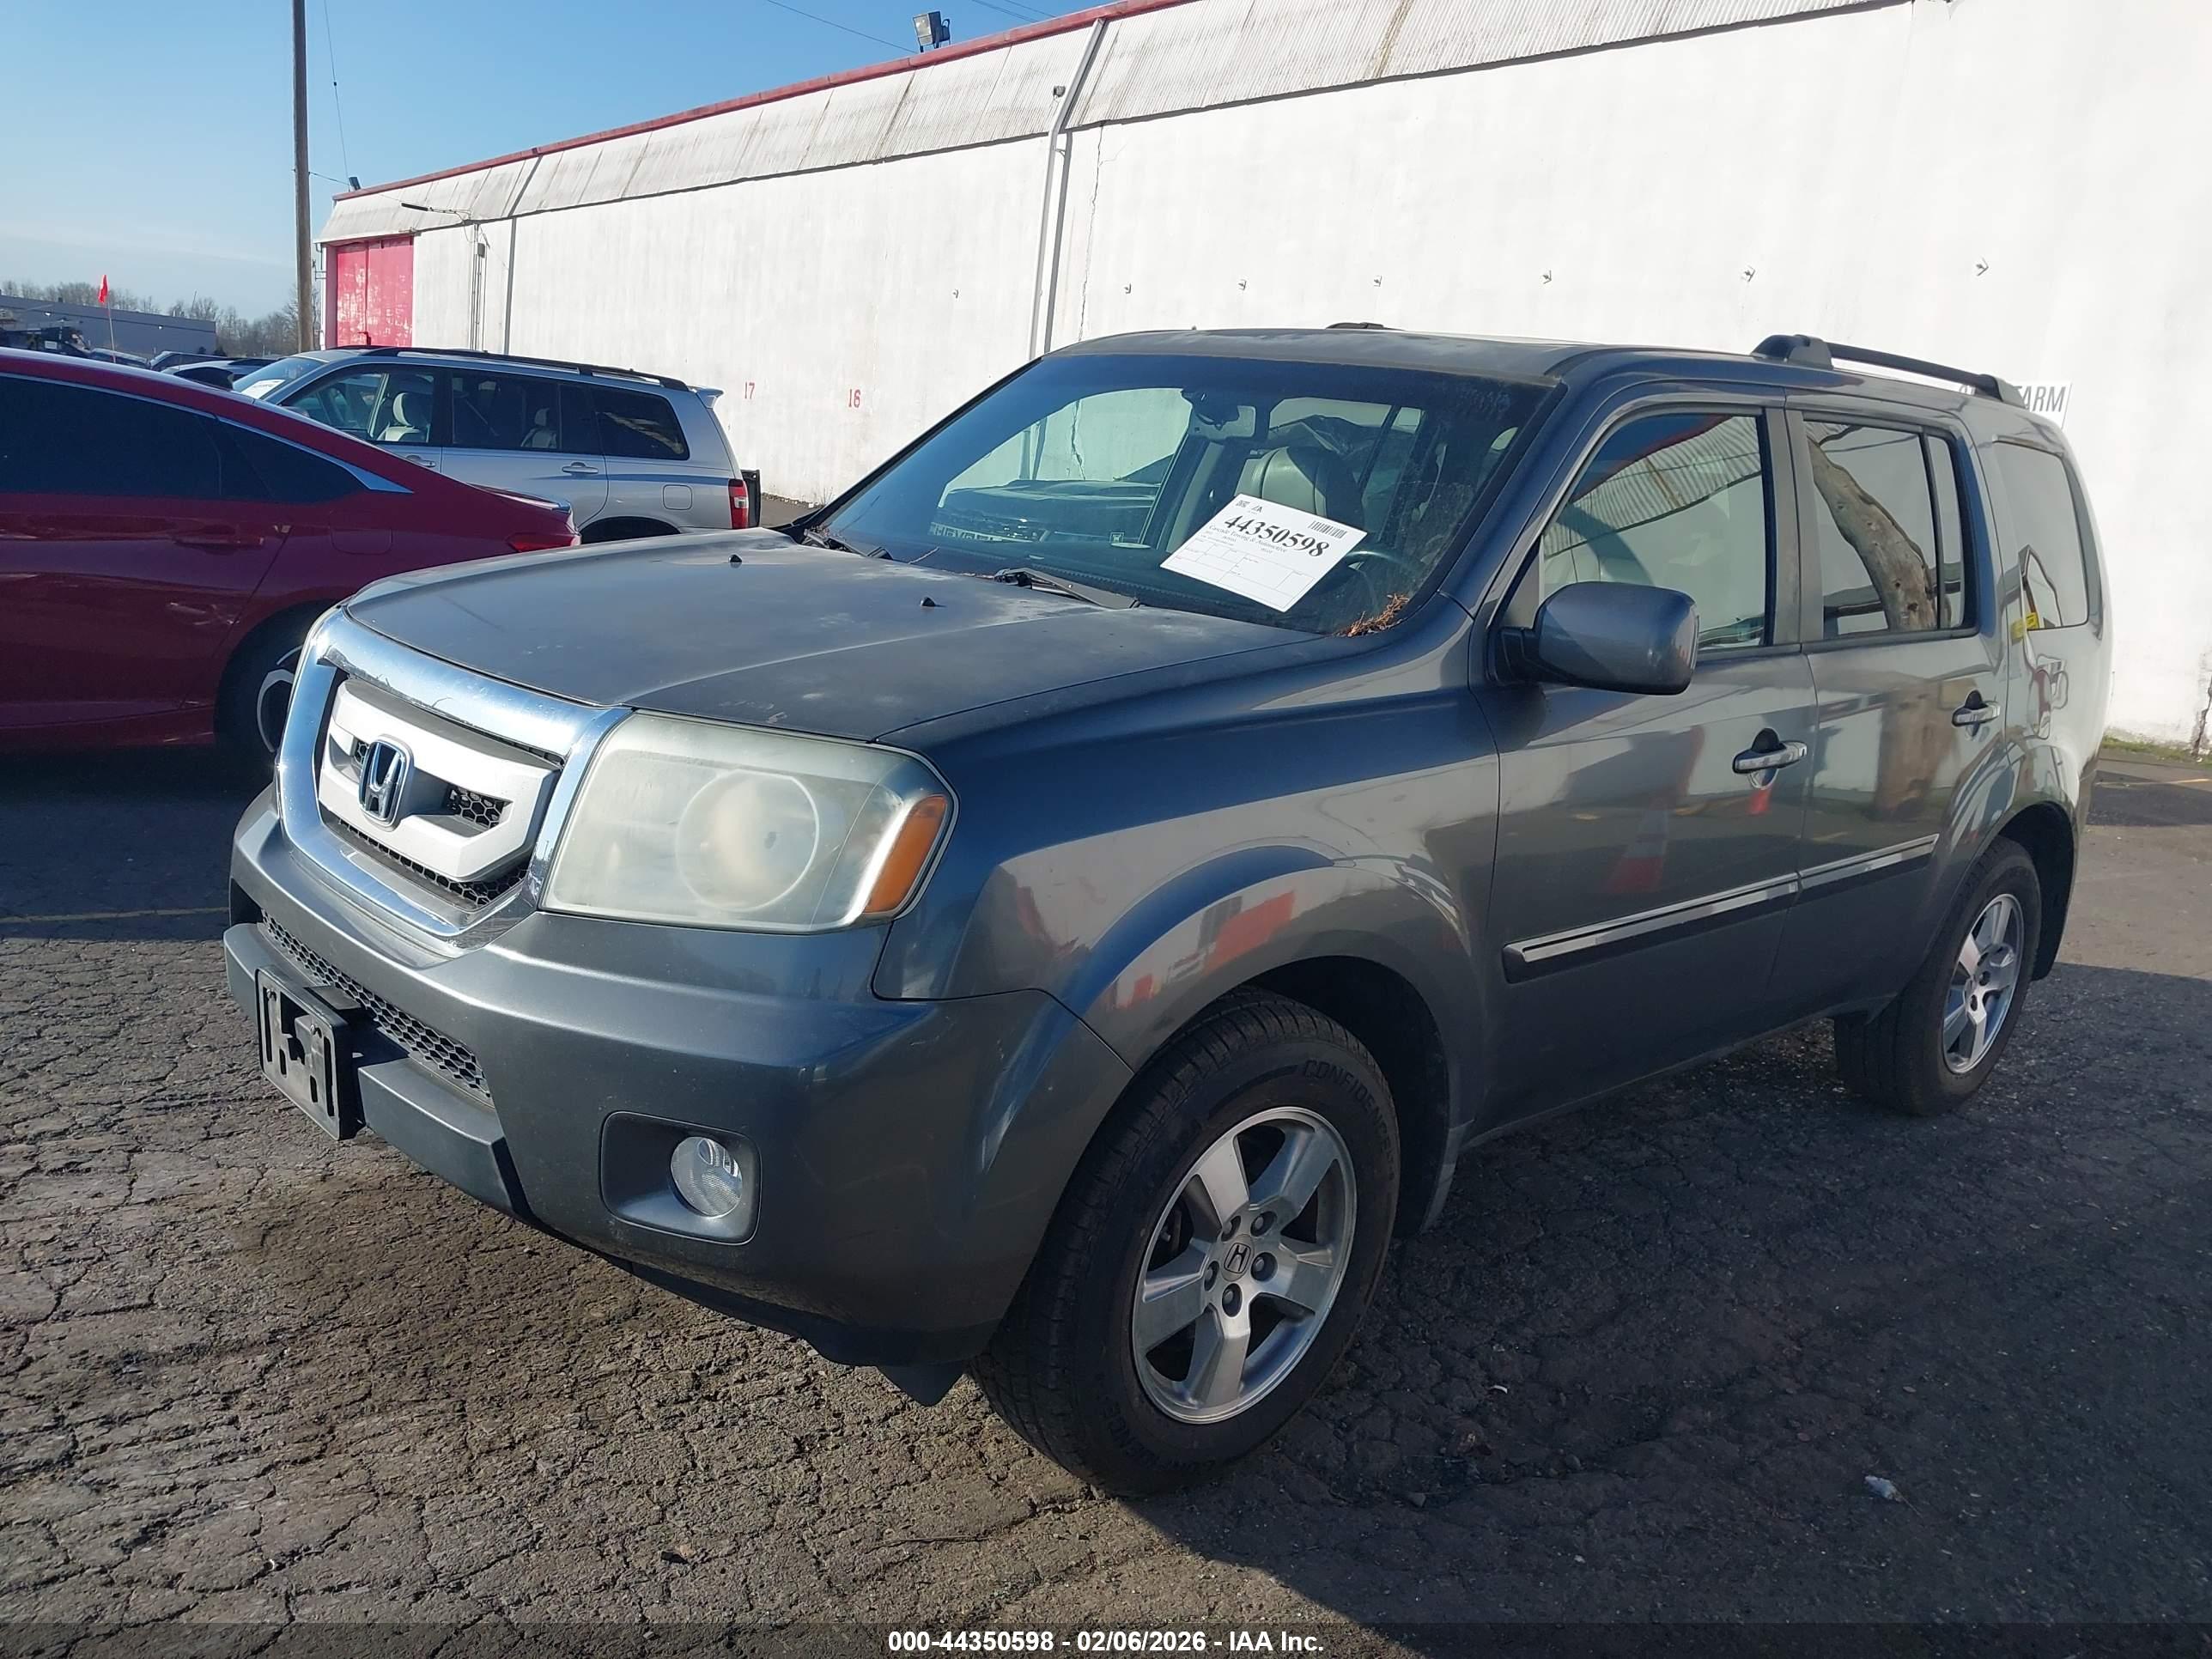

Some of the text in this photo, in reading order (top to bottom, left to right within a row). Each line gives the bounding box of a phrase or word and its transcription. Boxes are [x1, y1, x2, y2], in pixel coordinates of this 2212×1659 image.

[744, 381, 756, 399] 17
[848, 388, 861, 408] 16
[2019, 386, 2066, 412] ARM
[1224, 514, 1330, 557] 44350598
